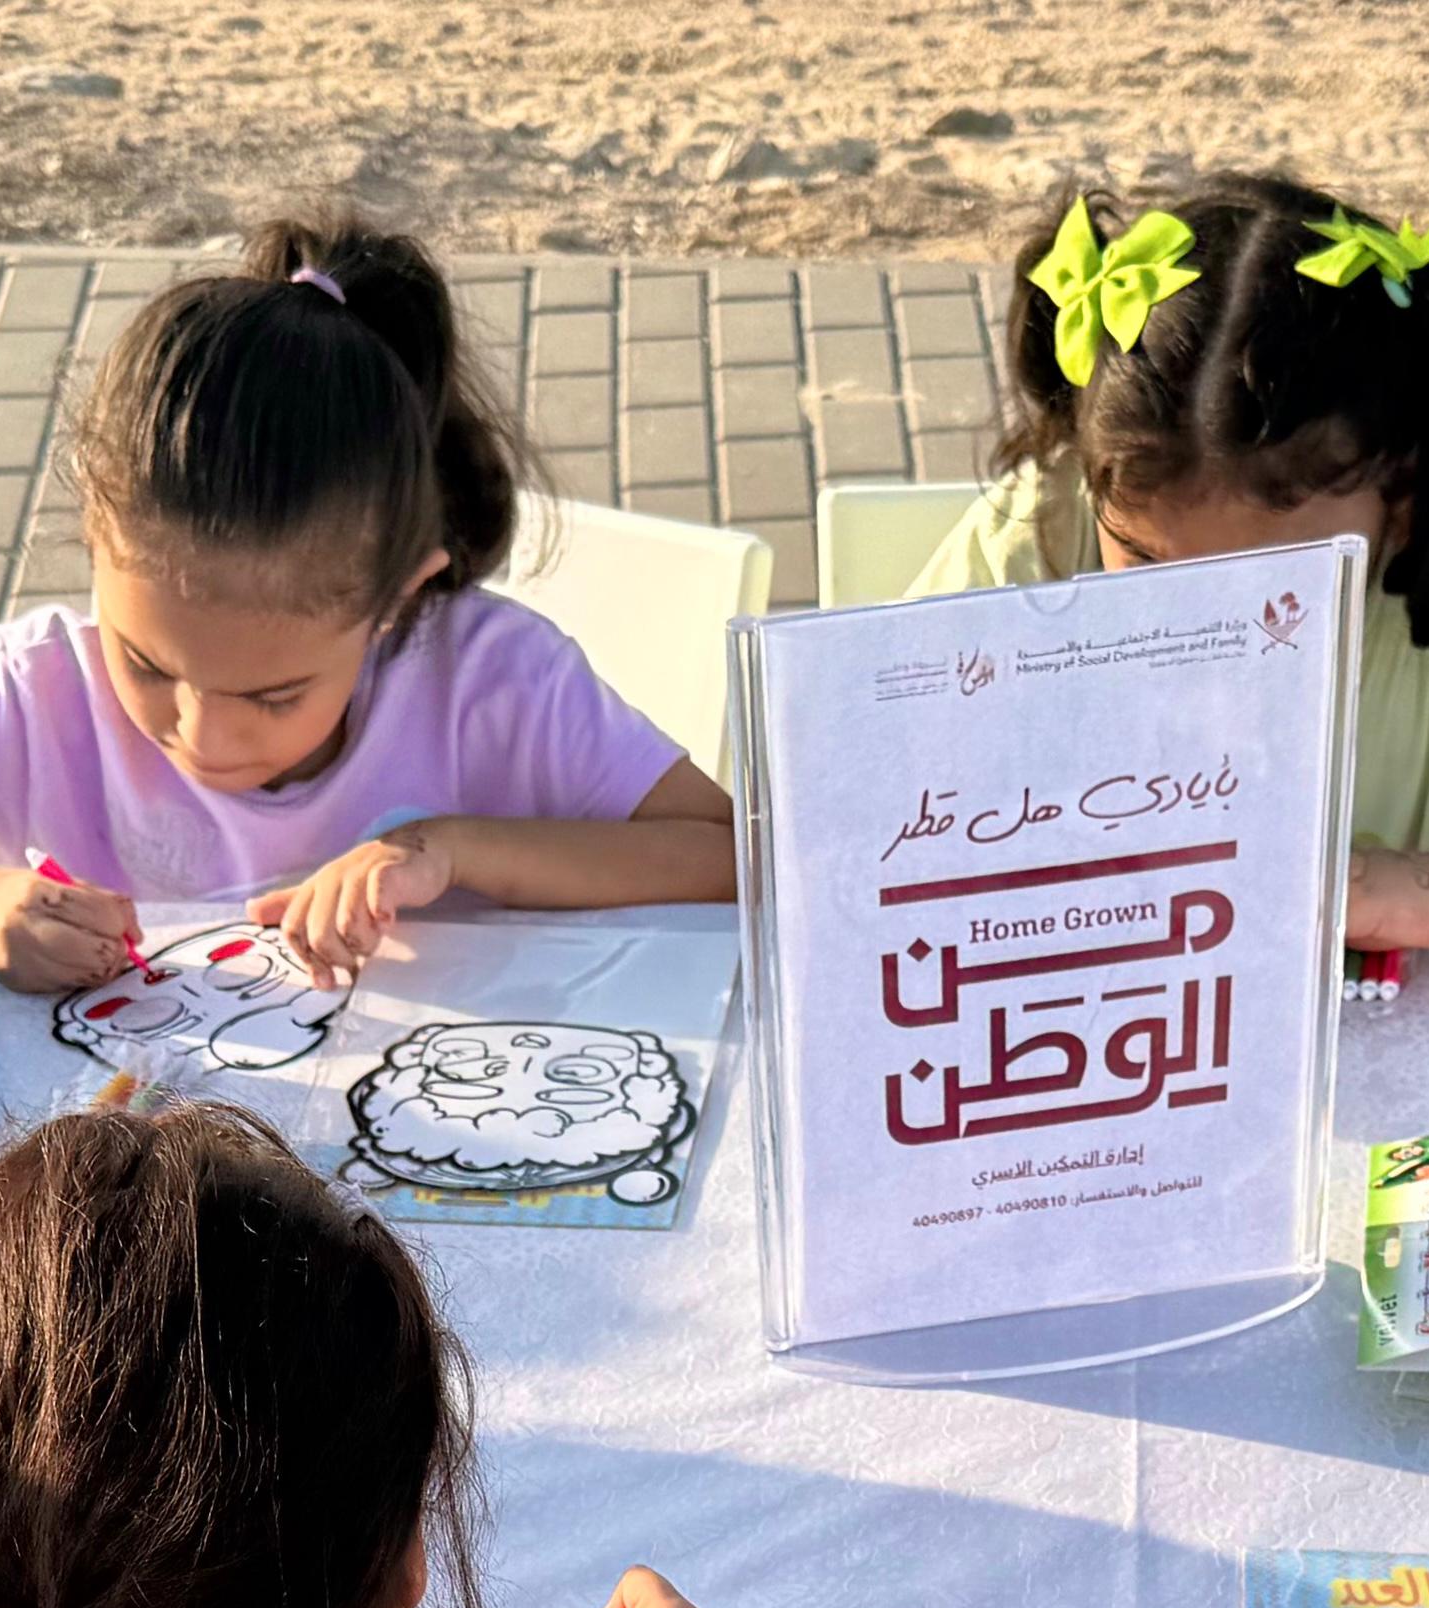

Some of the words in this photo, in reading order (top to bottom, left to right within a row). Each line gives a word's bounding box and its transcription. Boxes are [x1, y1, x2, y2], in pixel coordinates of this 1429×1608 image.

[1016, 661, 1061, 675] Ministry
[1078, 653, 1111, 667] Social
[1114, 643, 1186, 662] Development
[1188, 640, 1209, 652] and
[1211, 634, 1247, 649] Family
[880, 788, 959, 862] قطر
[966, 787, 1063, 844] هل
[969, 915, 1057, 944] Home
[1063, 902, 1159, 931] Grown
[881, 889, 1235, 1028] من
[1037, 1149, 1101, 1177] التمكين
[1107, 1143, 1145, 1166] إدارة
[1150, 1176, 1203, 1197] للتواصل
[912, 1206, 983, 1228] 40490897
[995, 1194, 1068, 1215] 40490810
